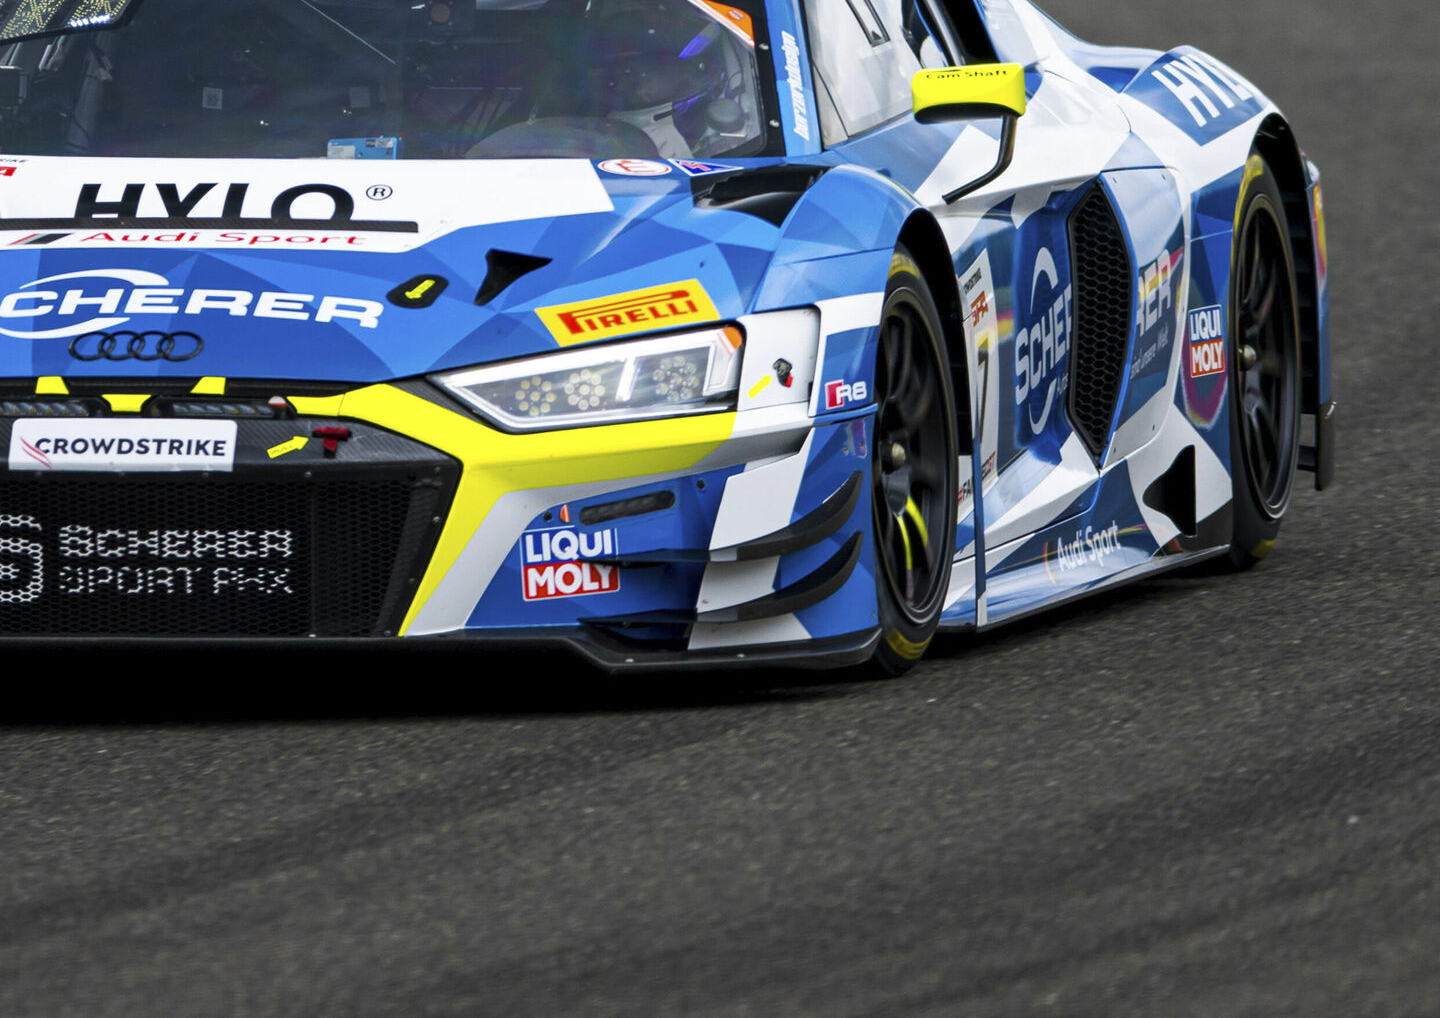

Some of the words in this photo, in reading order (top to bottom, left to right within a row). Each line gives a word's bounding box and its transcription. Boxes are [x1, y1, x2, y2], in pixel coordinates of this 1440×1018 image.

[925, 72, 961, 80] Cam
[964, 69, 1007, 78] Shaft
[80, 231, 201, 244] Audi
[219, 231, 366, 246] Sport
[556, 290, 698, 335] PIRELLI
[1190, 309, 1221, 341] LIQUI
[1191, 341, 1223, 373] MOLY
[35, 438, 227, 456] CROWDSTRIKE
[525, 529, 613, 563] LIQUI
[1057, 529, 1087, 572] Audi
[1085, 520, 1121, 567] Sport
[527, 563, 613, 597] MOLY
